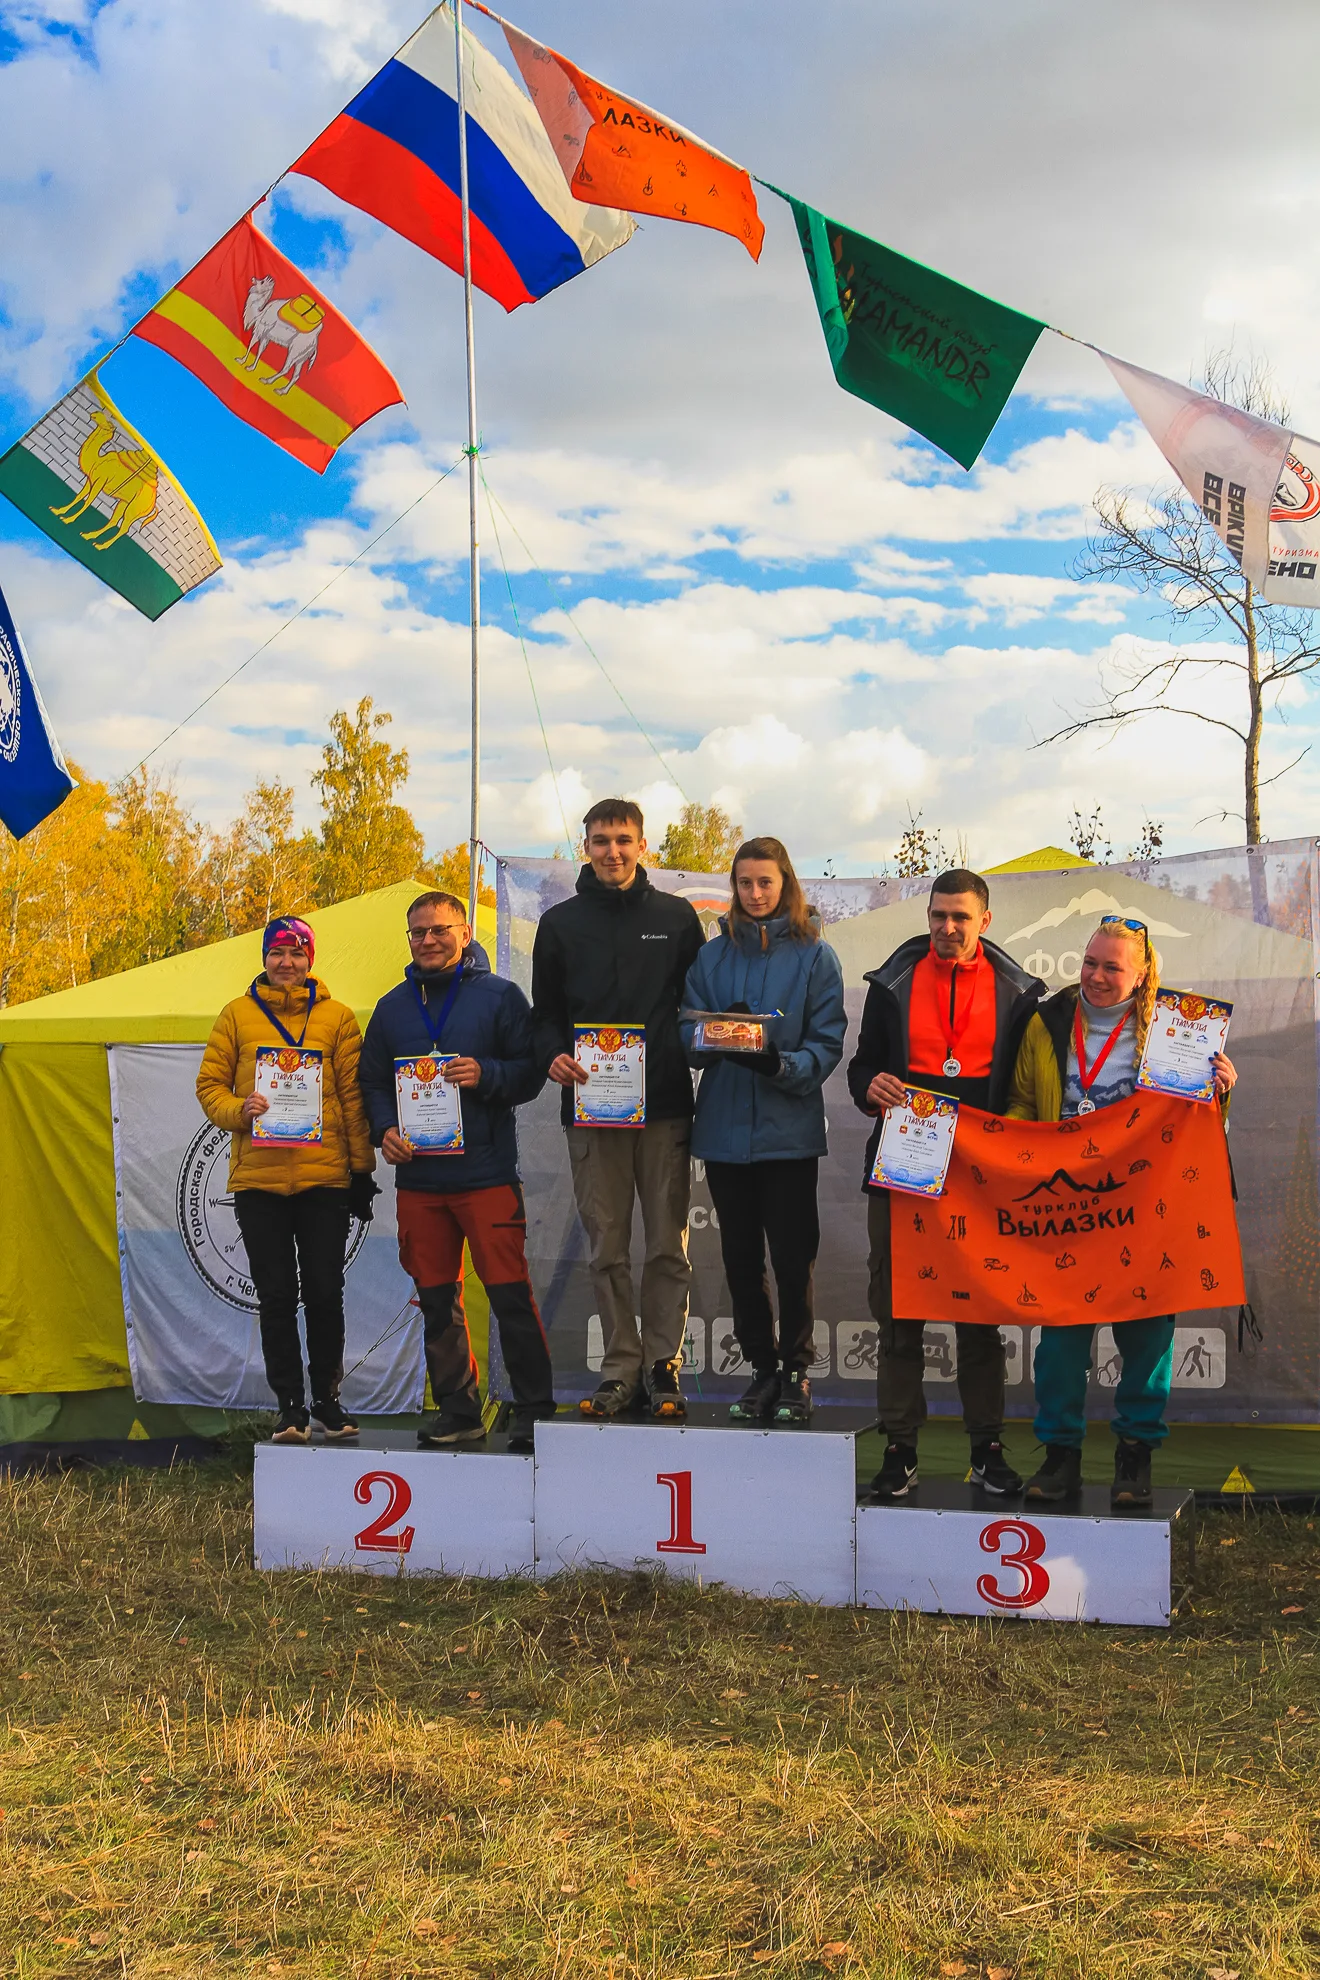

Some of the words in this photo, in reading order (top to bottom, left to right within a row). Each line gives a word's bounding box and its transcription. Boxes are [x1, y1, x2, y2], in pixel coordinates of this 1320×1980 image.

[602, 107, 687, 147] ЛАЗКИ
[1272, 545, 1319, 559] ТУРИЗМА
[0, 625, 21, 717] РАФИЧЕСКОЕ
[1022, 949, 1081, 981] ФС
[190, 1159, 206, 1248] Городская
[203, 1127, 229, 1157] фед
[1022, 1195, 1100, 1216] турклуб
[355, 1472, 415, 1553] 2
[656, 1471, 706, 1554] 1
[976, 1519, 1051, 1609] 3
